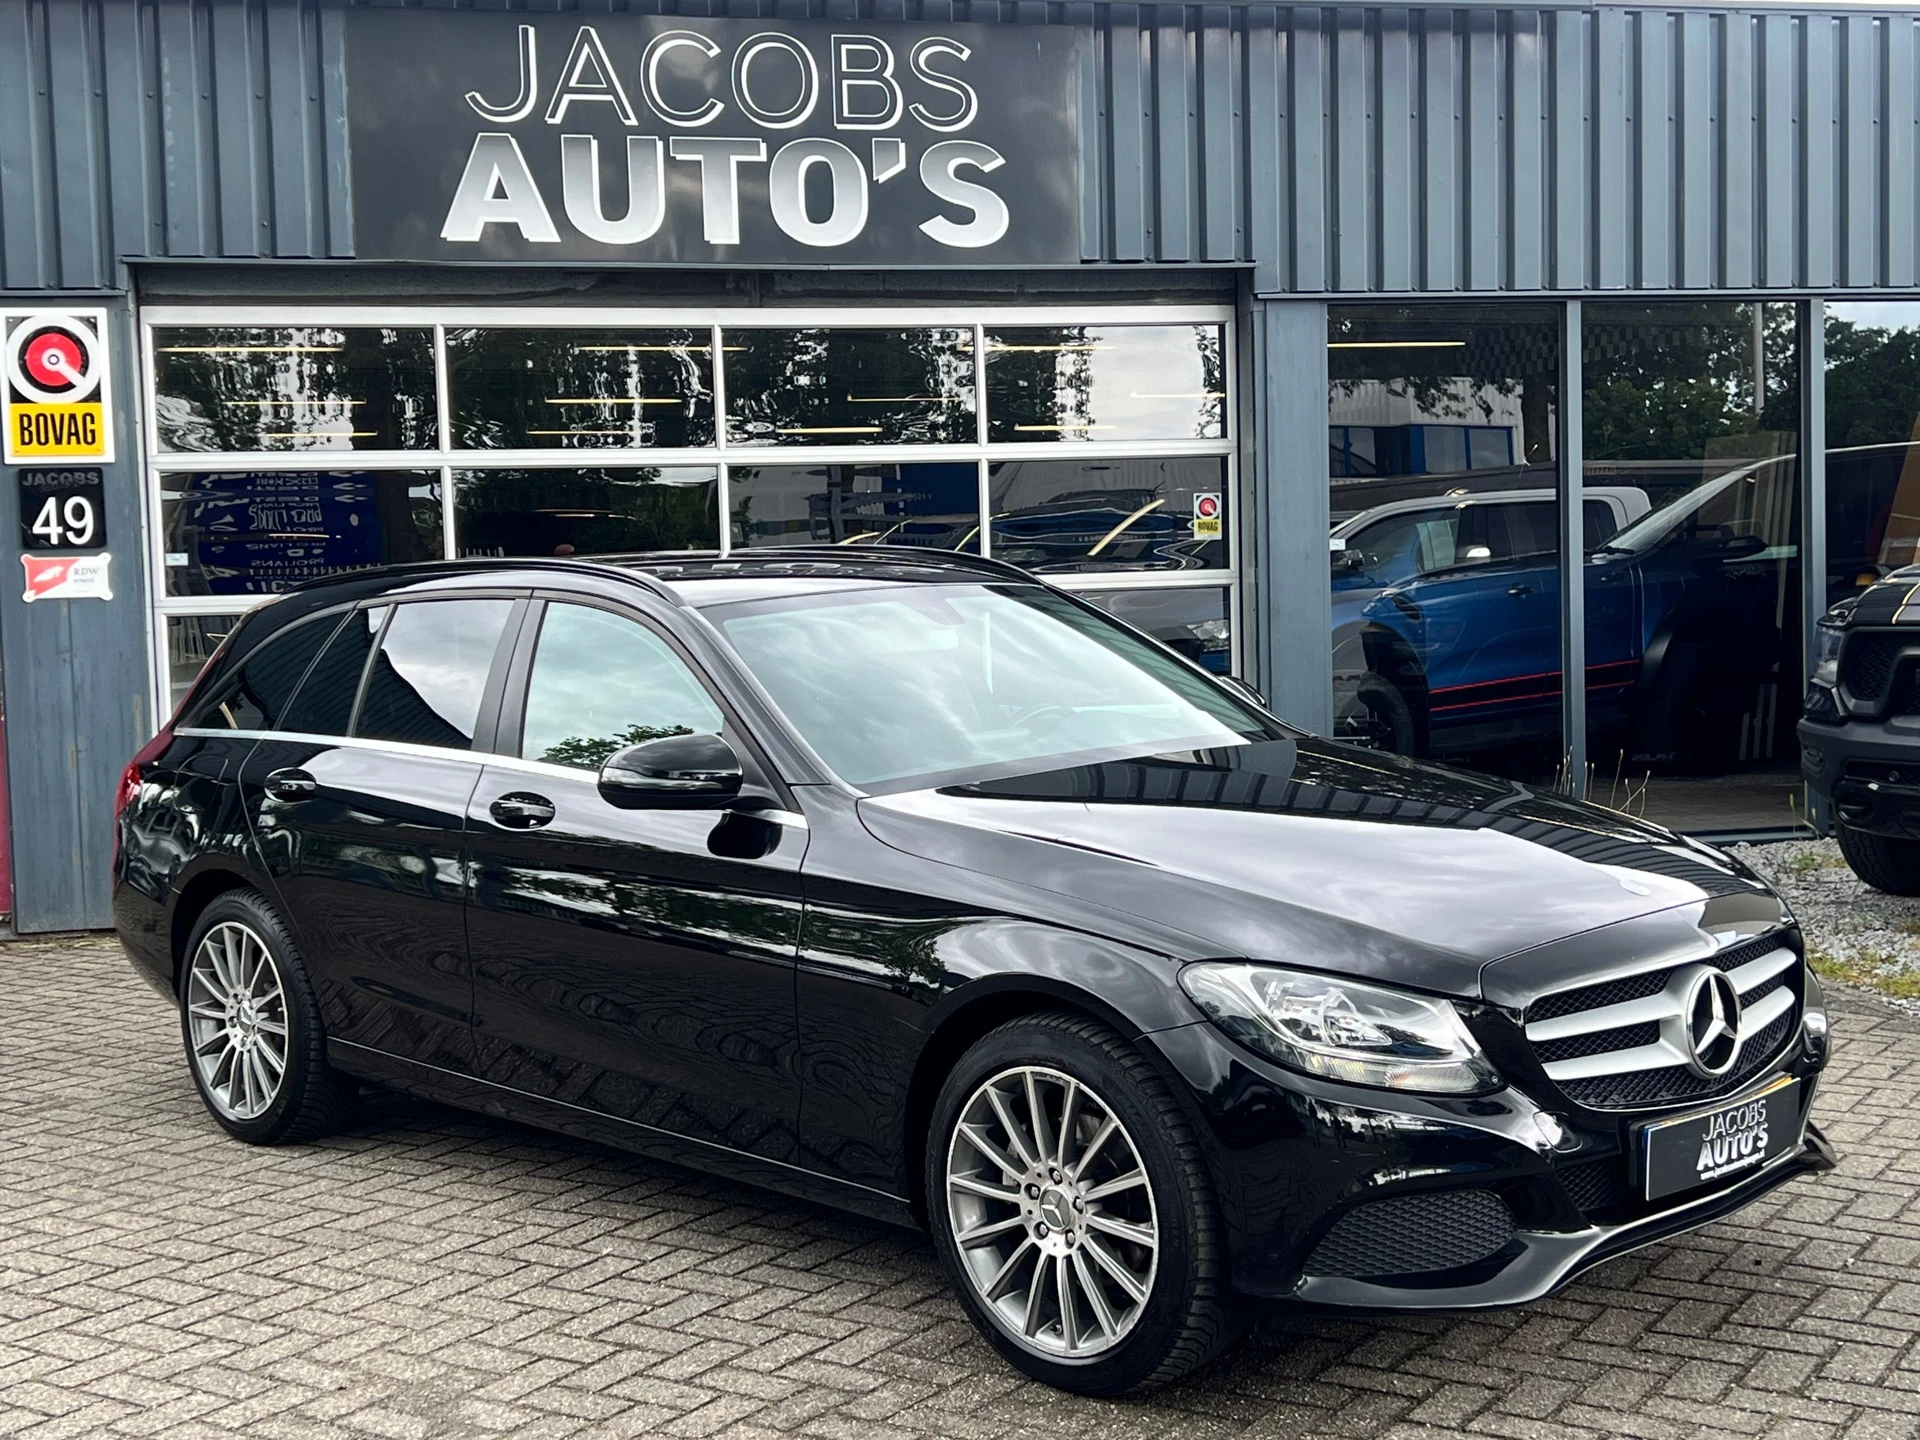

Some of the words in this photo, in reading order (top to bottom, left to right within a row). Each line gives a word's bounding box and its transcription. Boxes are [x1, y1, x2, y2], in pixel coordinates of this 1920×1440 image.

[465, 24, 978, 132] JACOBS
[440, 131, 1010, 249] AUTO'S
[19, 412, 96, 446] BOVAG
[22, 471, 99, 486] JACOBS
[32, 495, 94, 545] 49
[1197, 521, 1218, 532] BOVAG
[74, 567, 99, 576] RDW
[1702, 1099, 1766, 1141] JACOBS
[1696, 1121, 1769, 1171] AUTO'S
